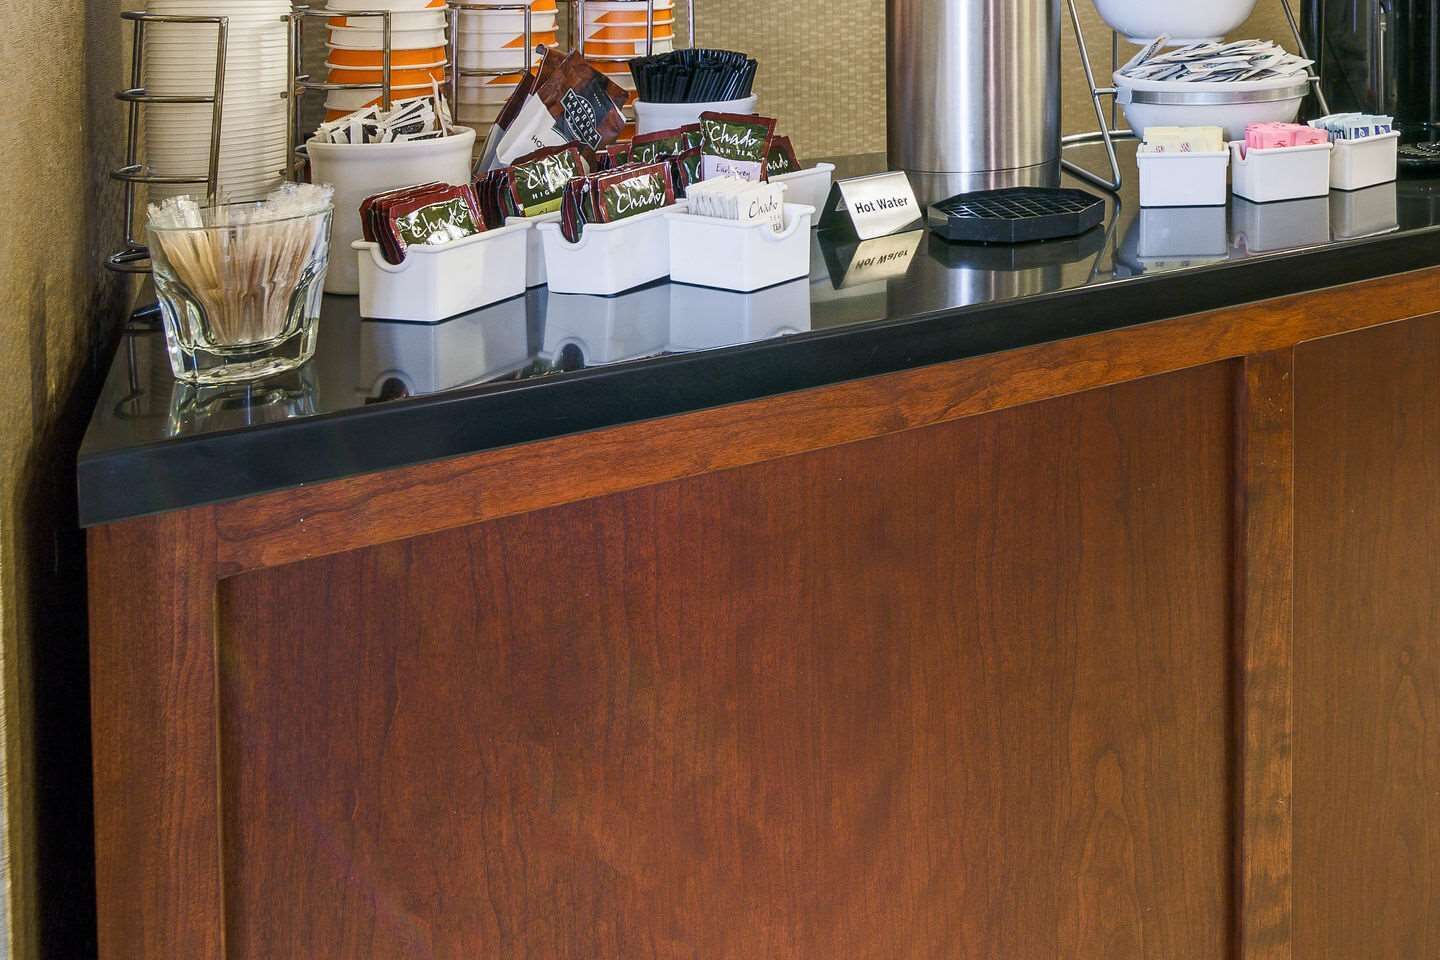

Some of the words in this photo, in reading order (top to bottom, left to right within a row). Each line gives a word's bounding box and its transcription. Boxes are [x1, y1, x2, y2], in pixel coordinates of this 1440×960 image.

[565, 101, 595, 144] MARKET
[566, 91, 600, 142] MADRONA
[706, 120, 761, 149] Chado
[616, 183, 662, 214] Chado
[748, 195, 779, 219] Chado
[854, 201, 876, 214] Hot
[876, 196, 909, 210] Water
